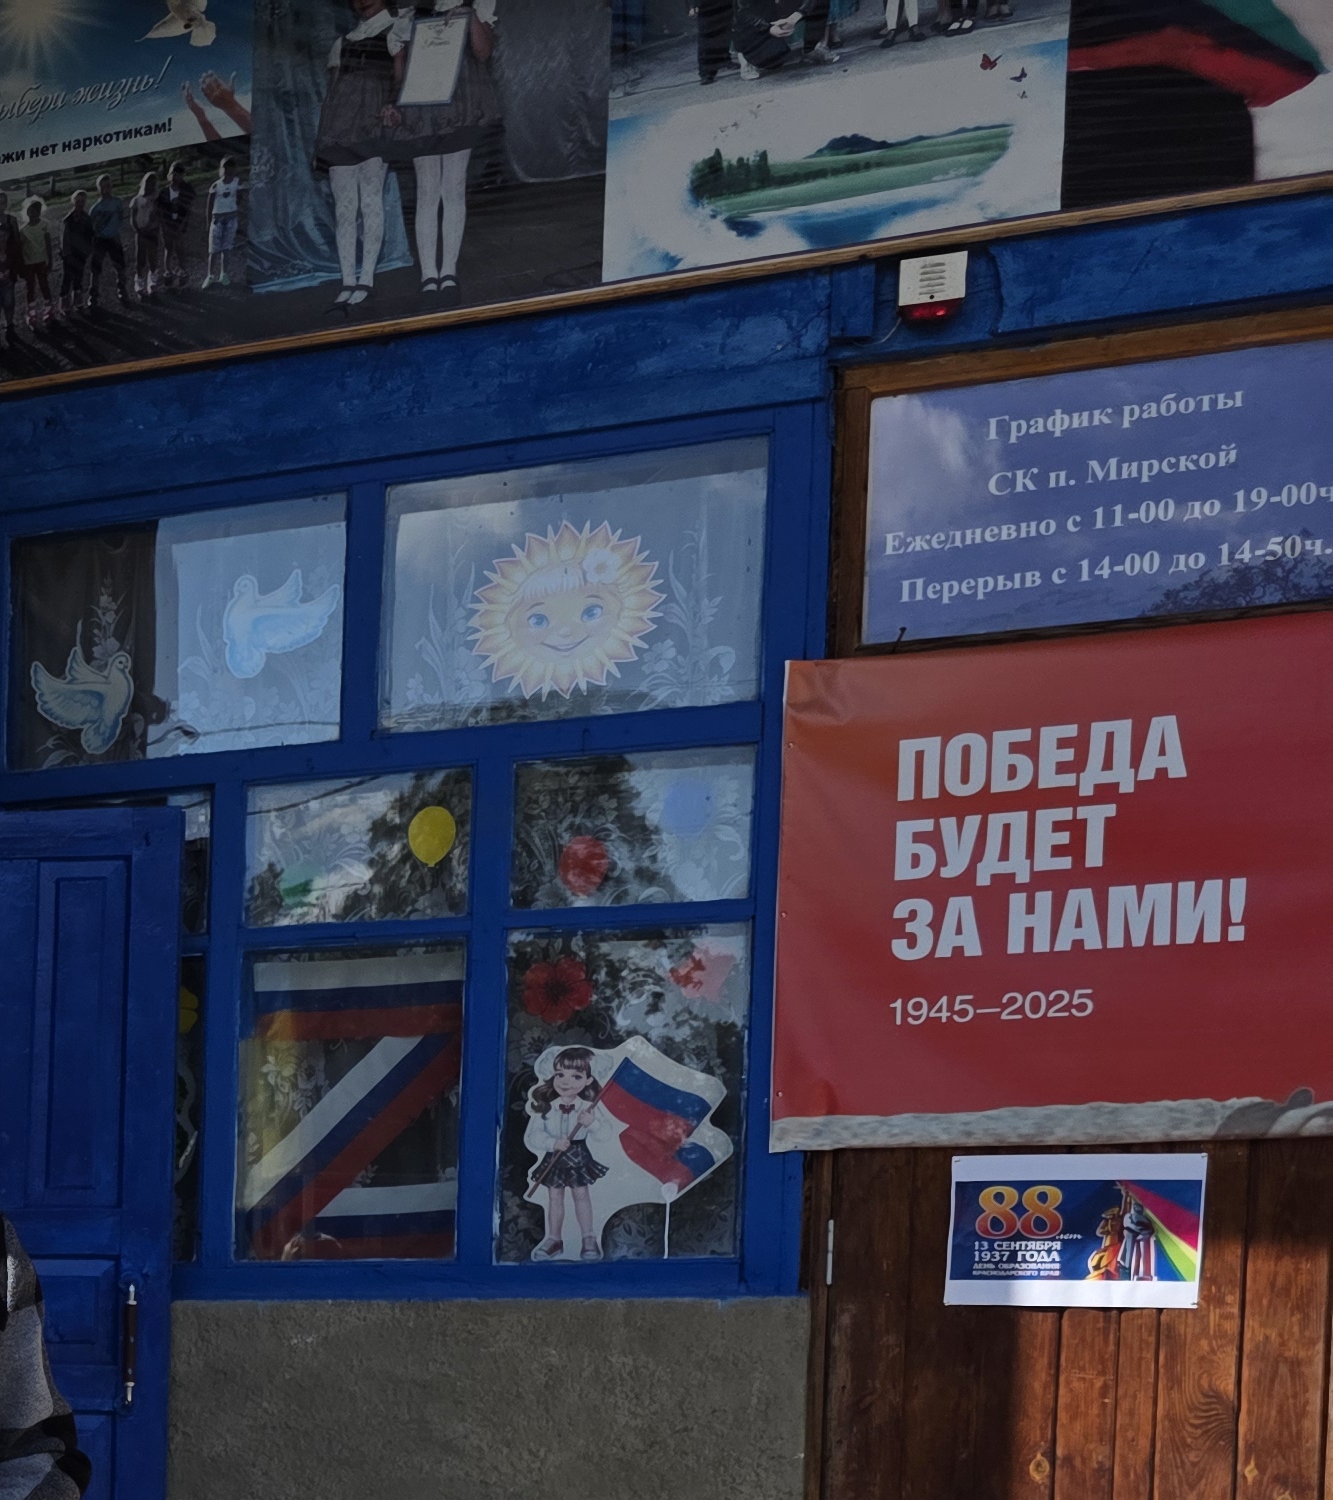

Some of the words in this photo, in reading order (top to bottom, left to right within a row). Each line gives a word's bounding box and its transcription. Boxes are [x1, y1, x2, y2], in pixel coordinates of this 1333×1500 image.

[73, 55, 173, 111] жизнь!
[30, 143, 58, 158] нет
[62, 117, 173, 152] наркотикам!
[986, 407, 1112, 443] График
[1122, 389, 1244, 428] работы
[987, 468, 1039, 496] СК
[1047, 469, 1077, 488] п.
[1087, 443, 1239, 484] Мирской
[884, 513, 1057, 556] Ежедневно
[1067, 515, 1082, 533] с
[1093, 498, 1175, 529] 11-00
[1183, 498, 1222, 525] до
[900, 567, 1042, 604] Перерыв
[1052, 566, 1067, 585] с
[1079, 550, 1161, 581] 14-00
[1169, 551, 1206, 576] до
[1218, 534, 1333, 566] 14-50ч.
[897, 715, 1187, 801] ПОБЕДА
[894, 804, 1116, 886] БУДЕТ
[890, 896, 982, 961] ЗА
[1007, 878, 1247, 955] НАМИ!
[975, 1185, 1062, 1239] 88
[974, 1241, 989, 1250] 13
[993, 1241, 1062, 1251] СЕНТЯБРЯ
[974, 1251, 1010, 1261] 1937
[1017, 1251, 1061, 1263] ГОДА
